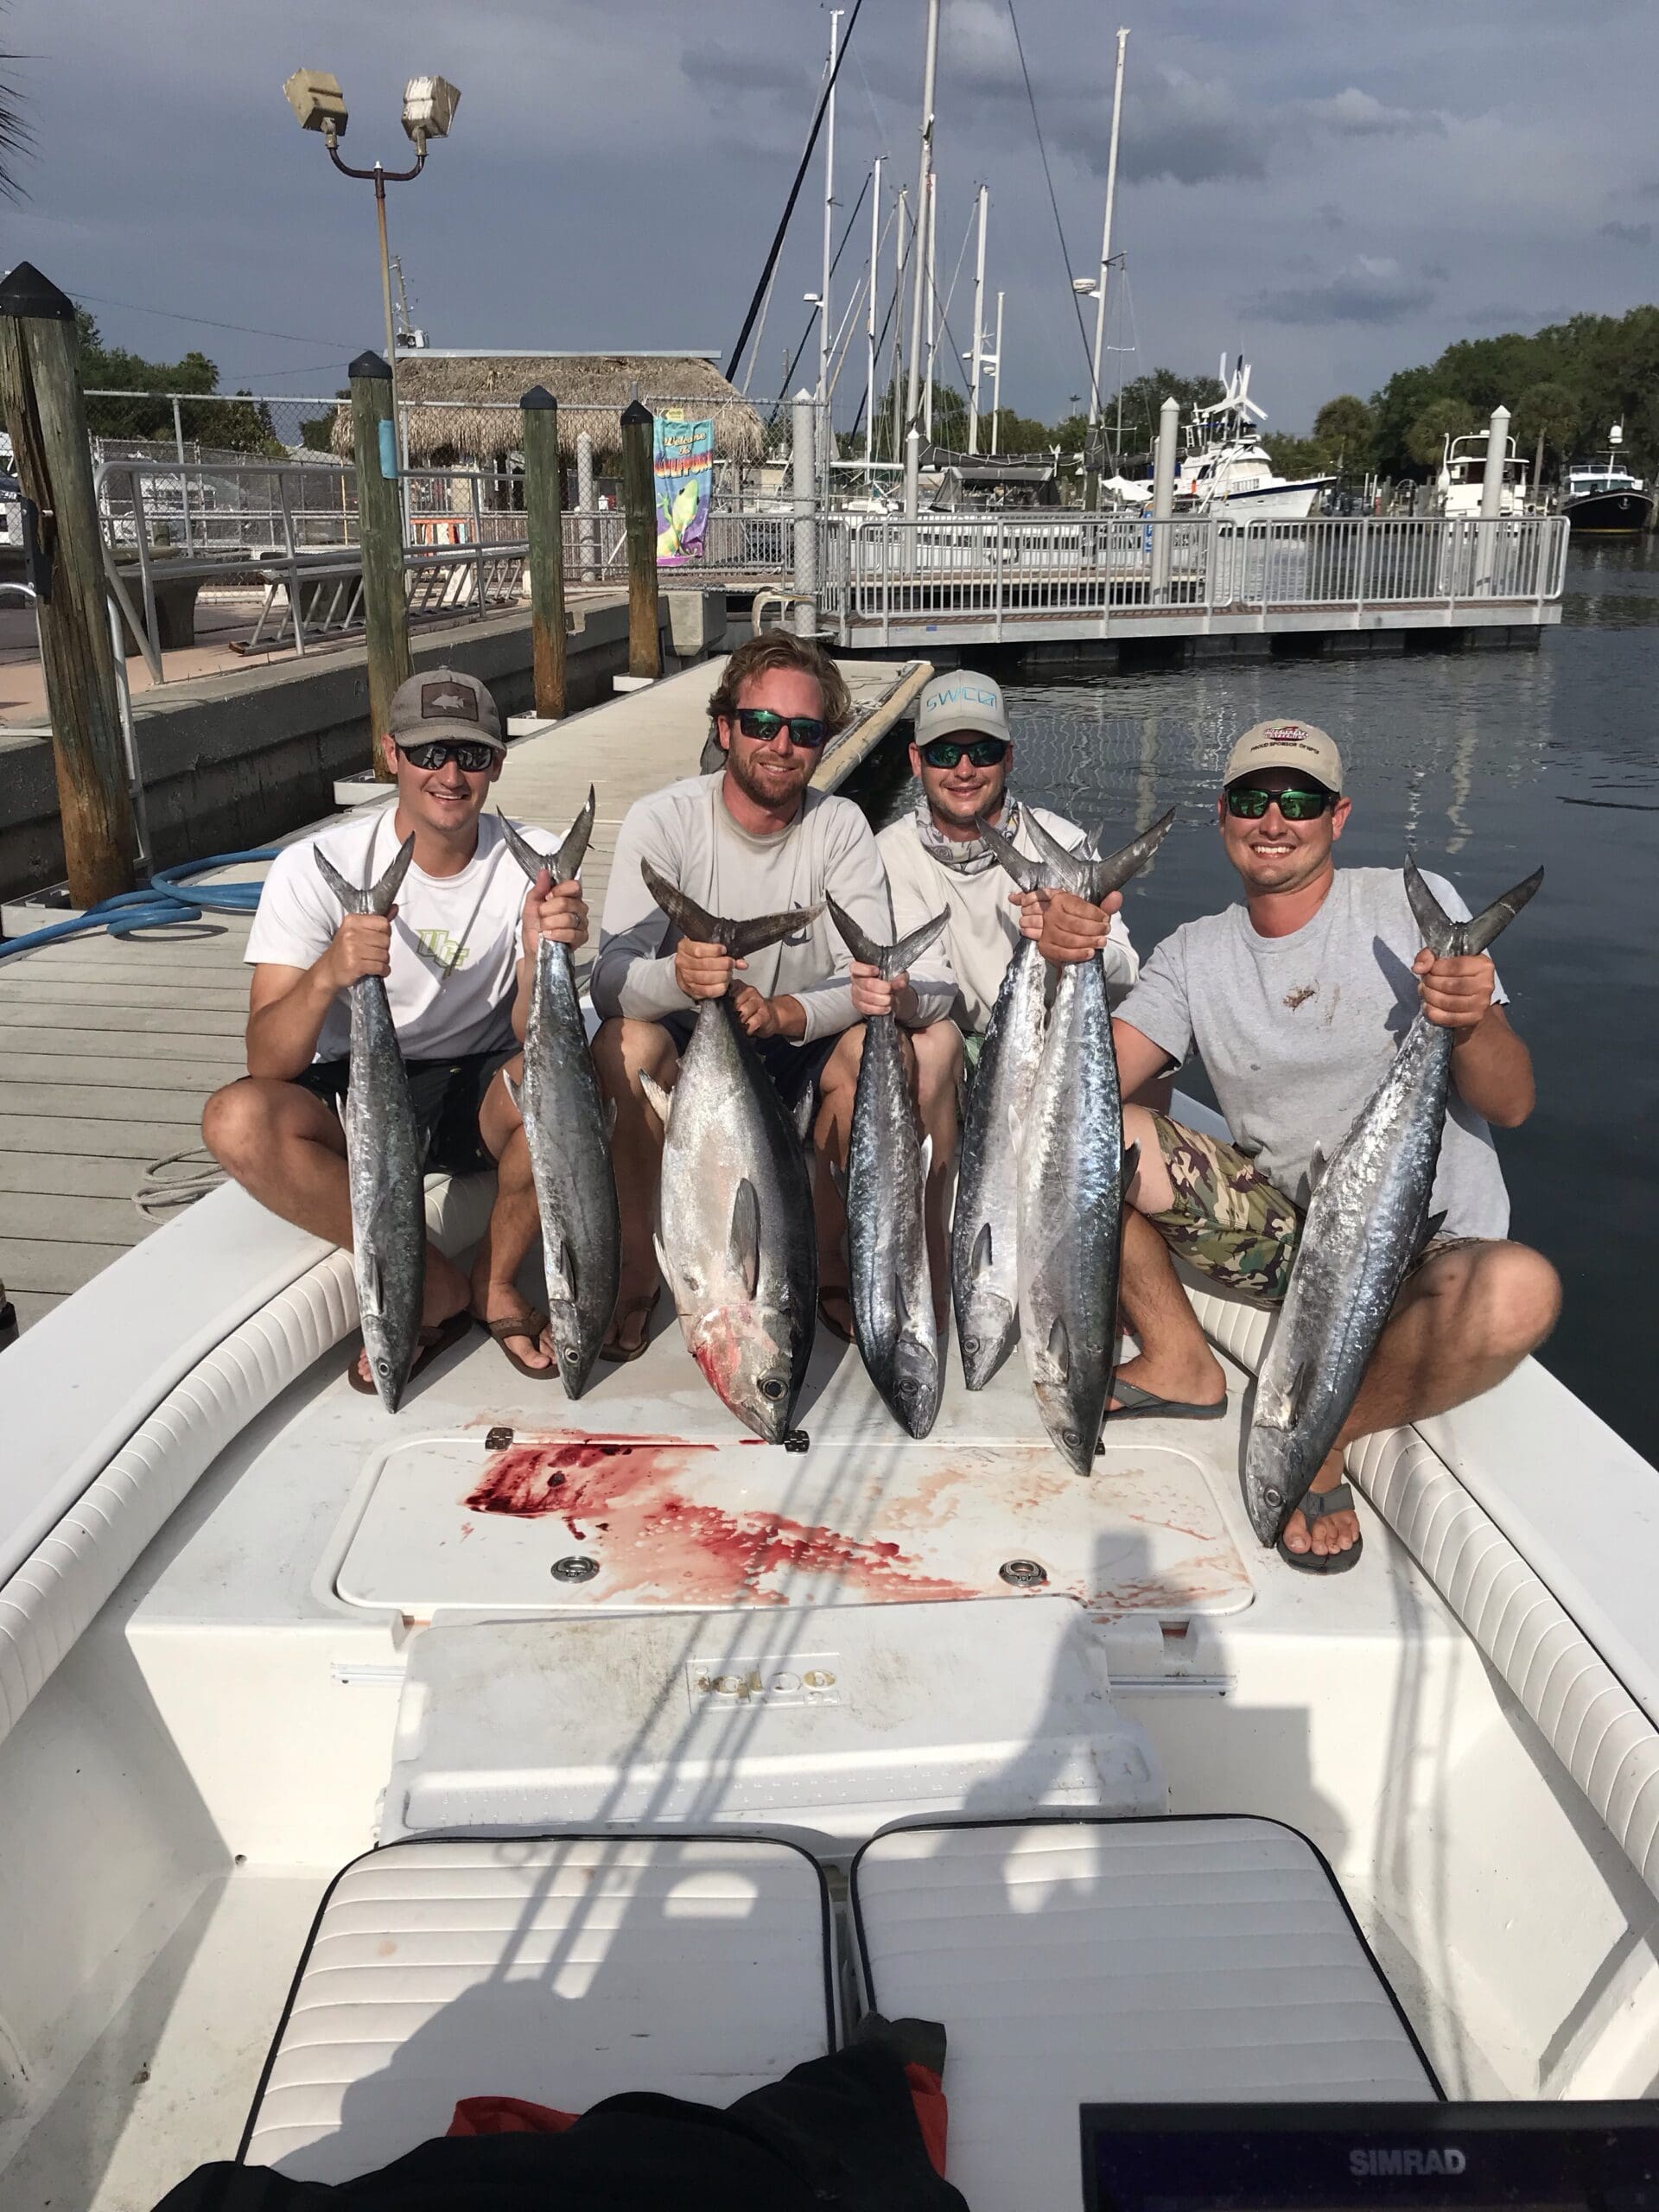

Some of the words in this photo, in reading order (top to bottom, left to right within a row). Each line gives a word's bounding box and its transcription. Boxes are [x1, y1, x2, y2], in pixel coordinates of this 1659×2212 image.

[664, 433, 707, 447] Welcome
[1250, 742, 1269, 752] PROUD
[1349, 2149, 1467, 2176] SIMRAD
